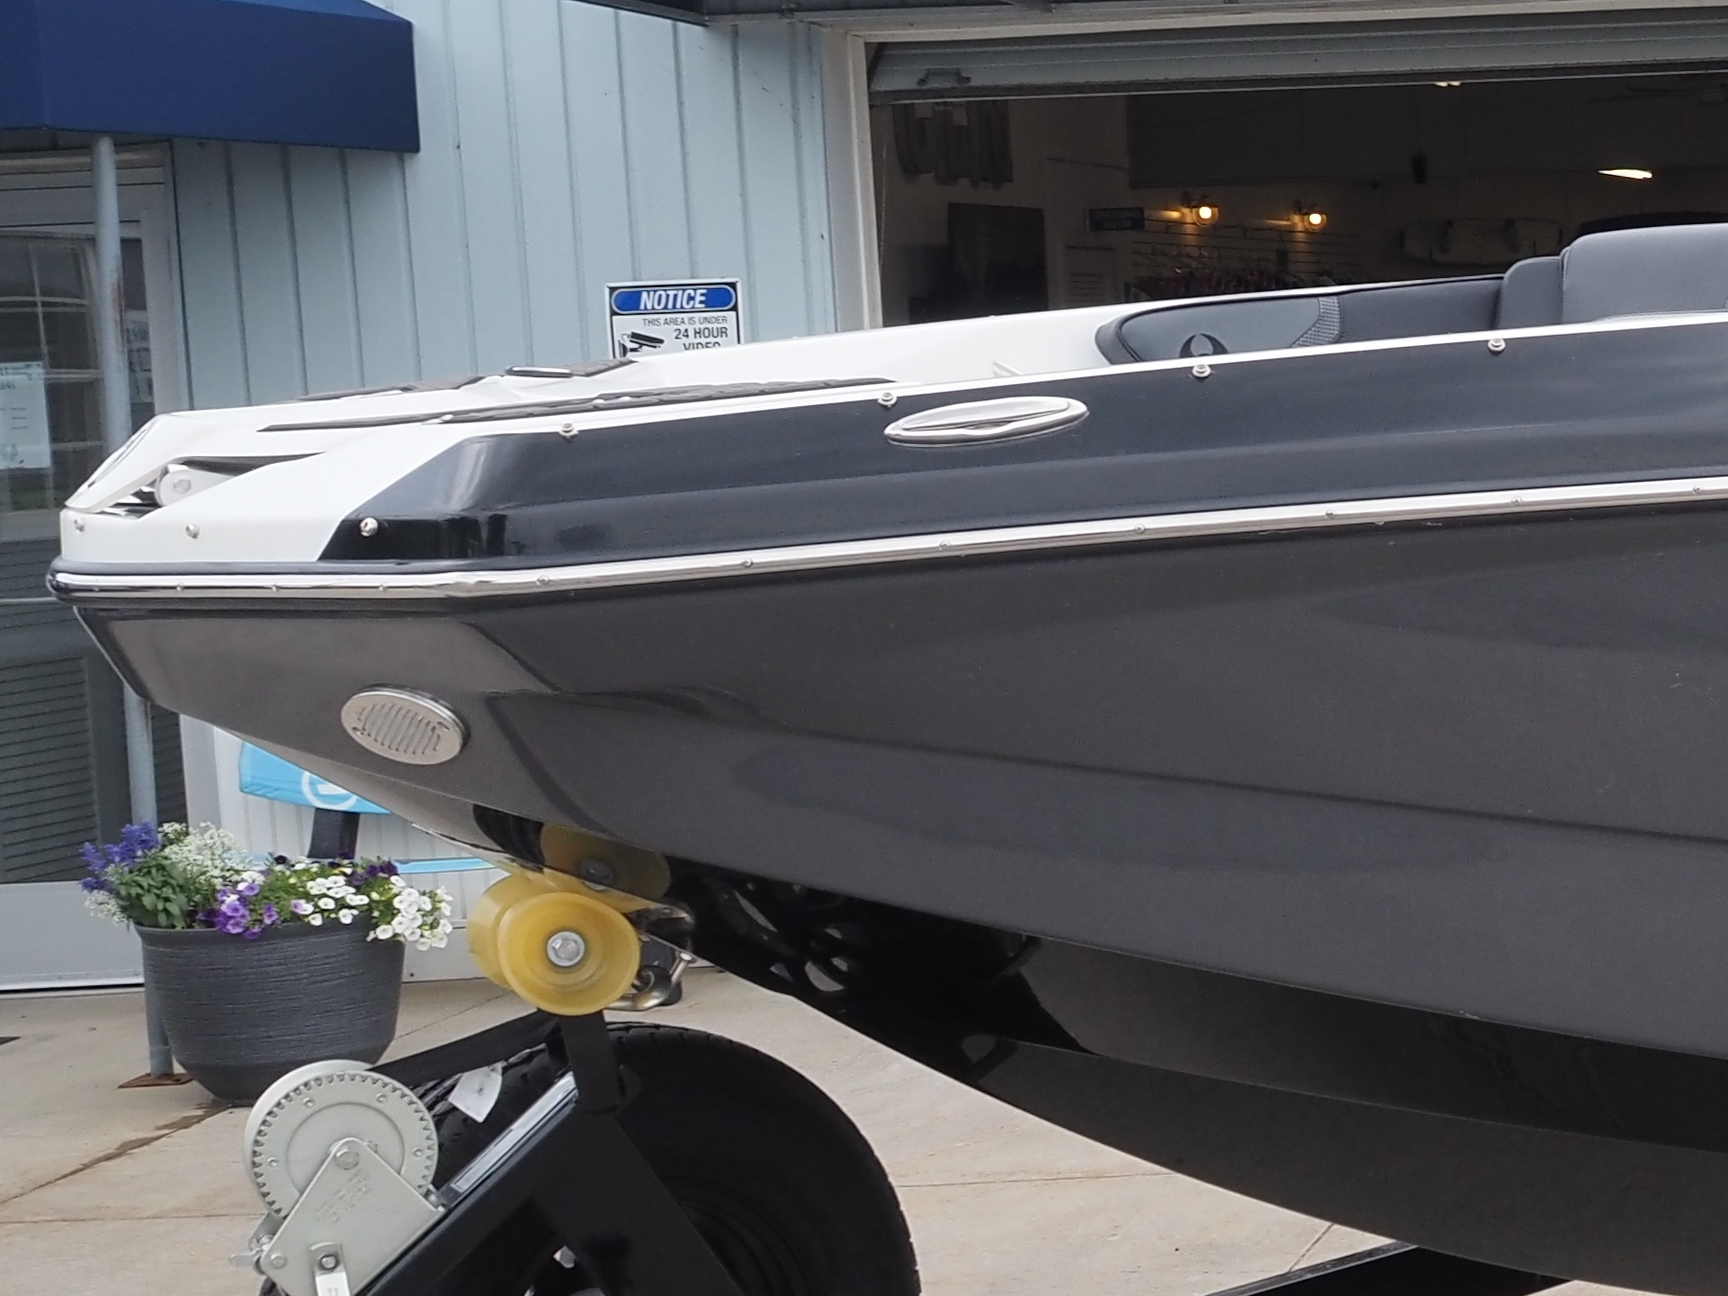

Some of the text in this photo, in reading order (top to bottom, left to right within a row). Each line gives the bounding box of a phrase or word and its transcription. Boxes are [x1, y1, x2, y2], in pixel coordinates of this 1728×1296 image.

[639, 289, 707, 310] NOTICE
[642, 315, 728, 326] THIS AREA IS UNDER
[674, 326, 728, 339] 24 HOUR
